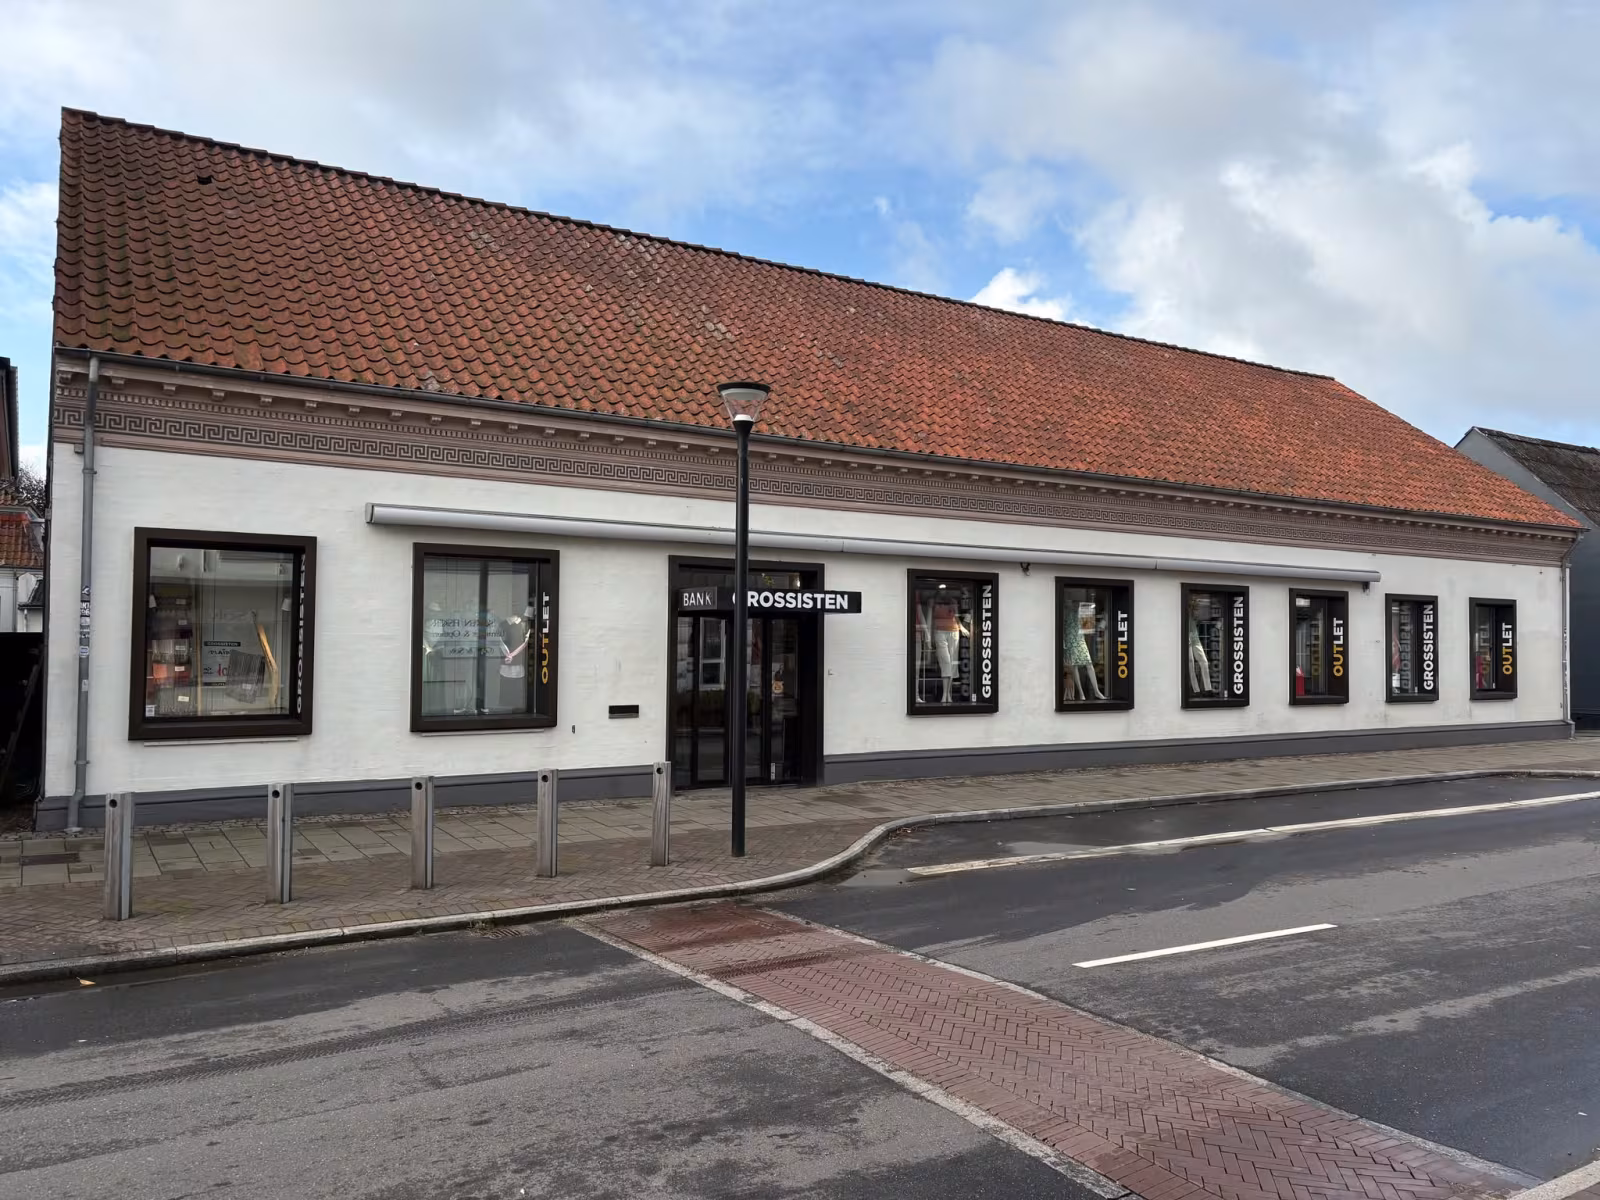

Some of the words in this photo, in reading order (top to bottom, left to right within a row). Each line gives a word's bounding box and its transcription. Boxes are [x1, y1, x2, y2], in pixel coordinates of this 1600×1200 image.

[683, 592, 712, 607] BANK
[732, 591, 849, 610] ROSSISTEN
[541, 592, 550, 684] OUTLET
[982, 585, 992, 699] GROSSISTEN
[1117, 610, 1128, 679] OUTLET
[1233, 596, 1244, 695] GROSSISTEN
[1333, 617, 1344, 677] OUTLET
[1423, 604, 1434, 691] GROSSISTEN
[1502, 622, 1513, 675] OUTLET
